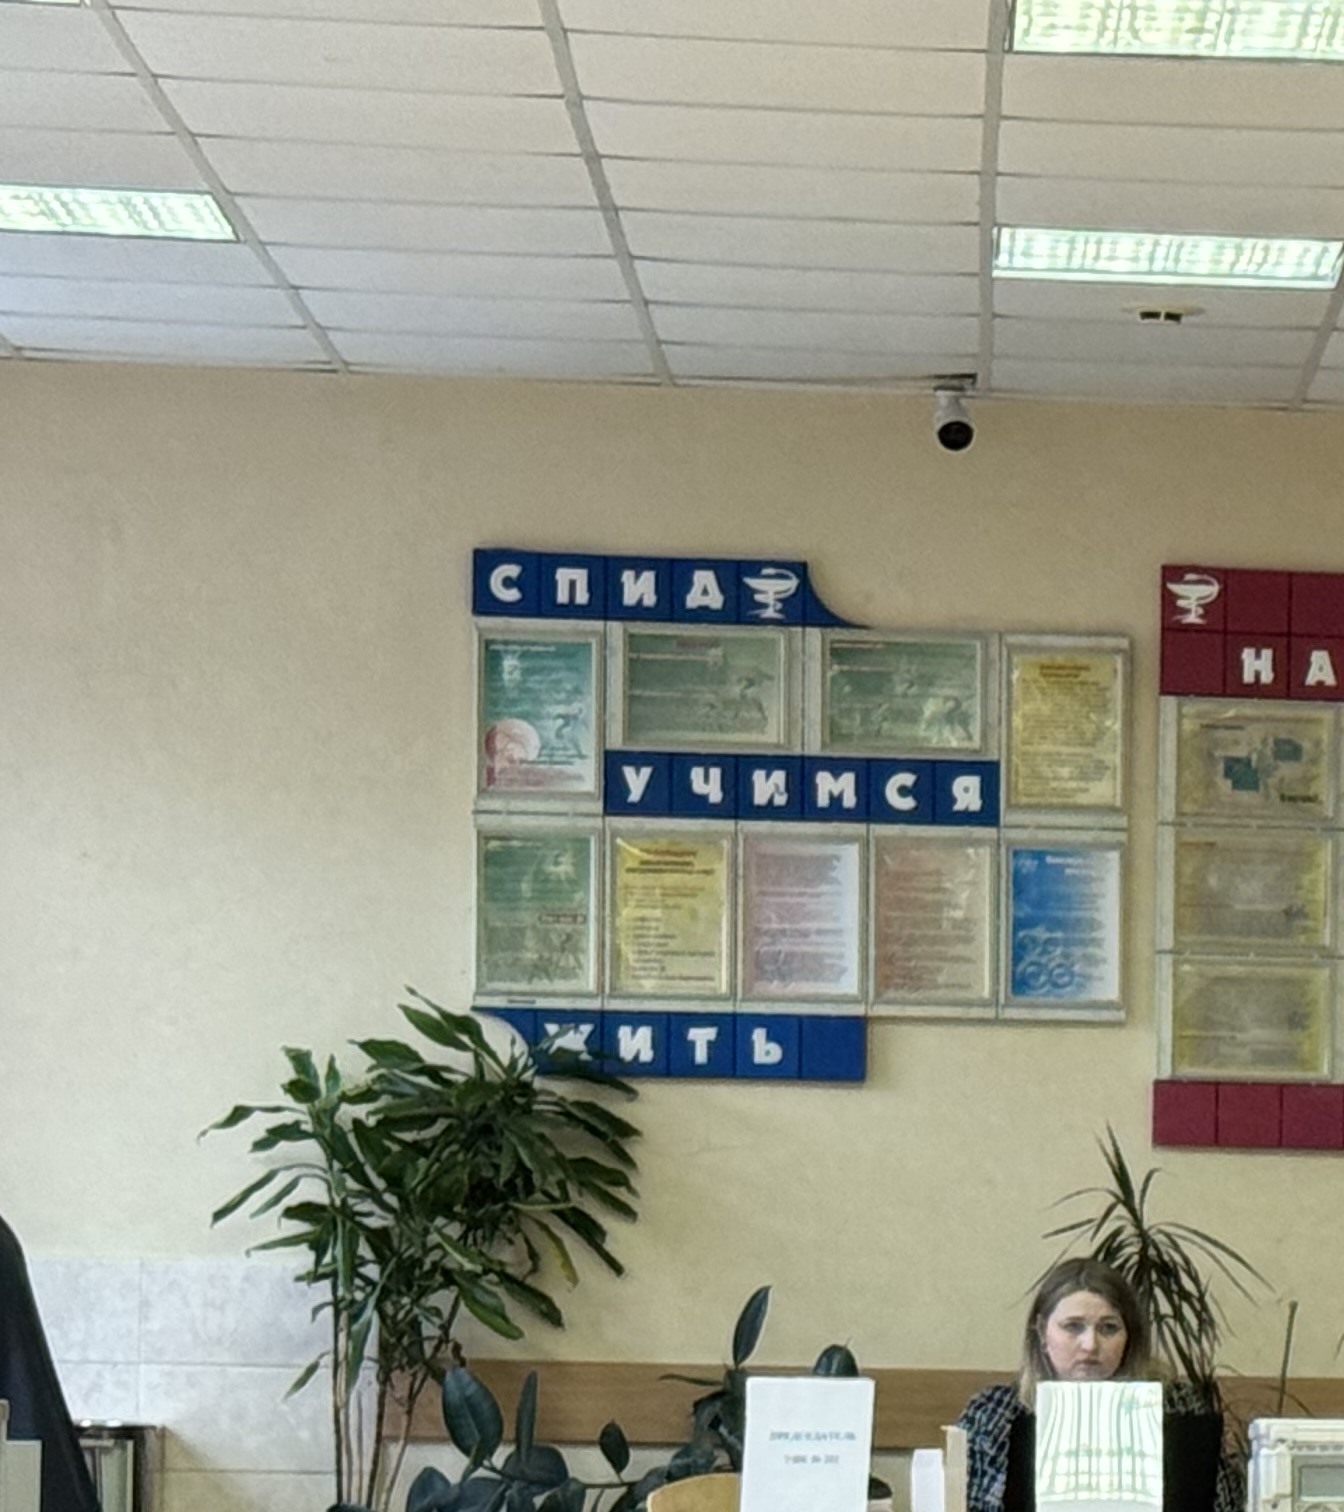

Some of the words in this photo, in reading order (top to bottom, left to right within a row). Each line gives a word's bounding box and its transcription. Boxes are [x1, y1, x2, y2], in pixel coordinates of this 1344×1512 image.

[490, 564, 724, 609] СПИД
[621, 766, 982, 811] УЧИМСЯ
[543, 1023, 783, 1065] ЖИТЬ
